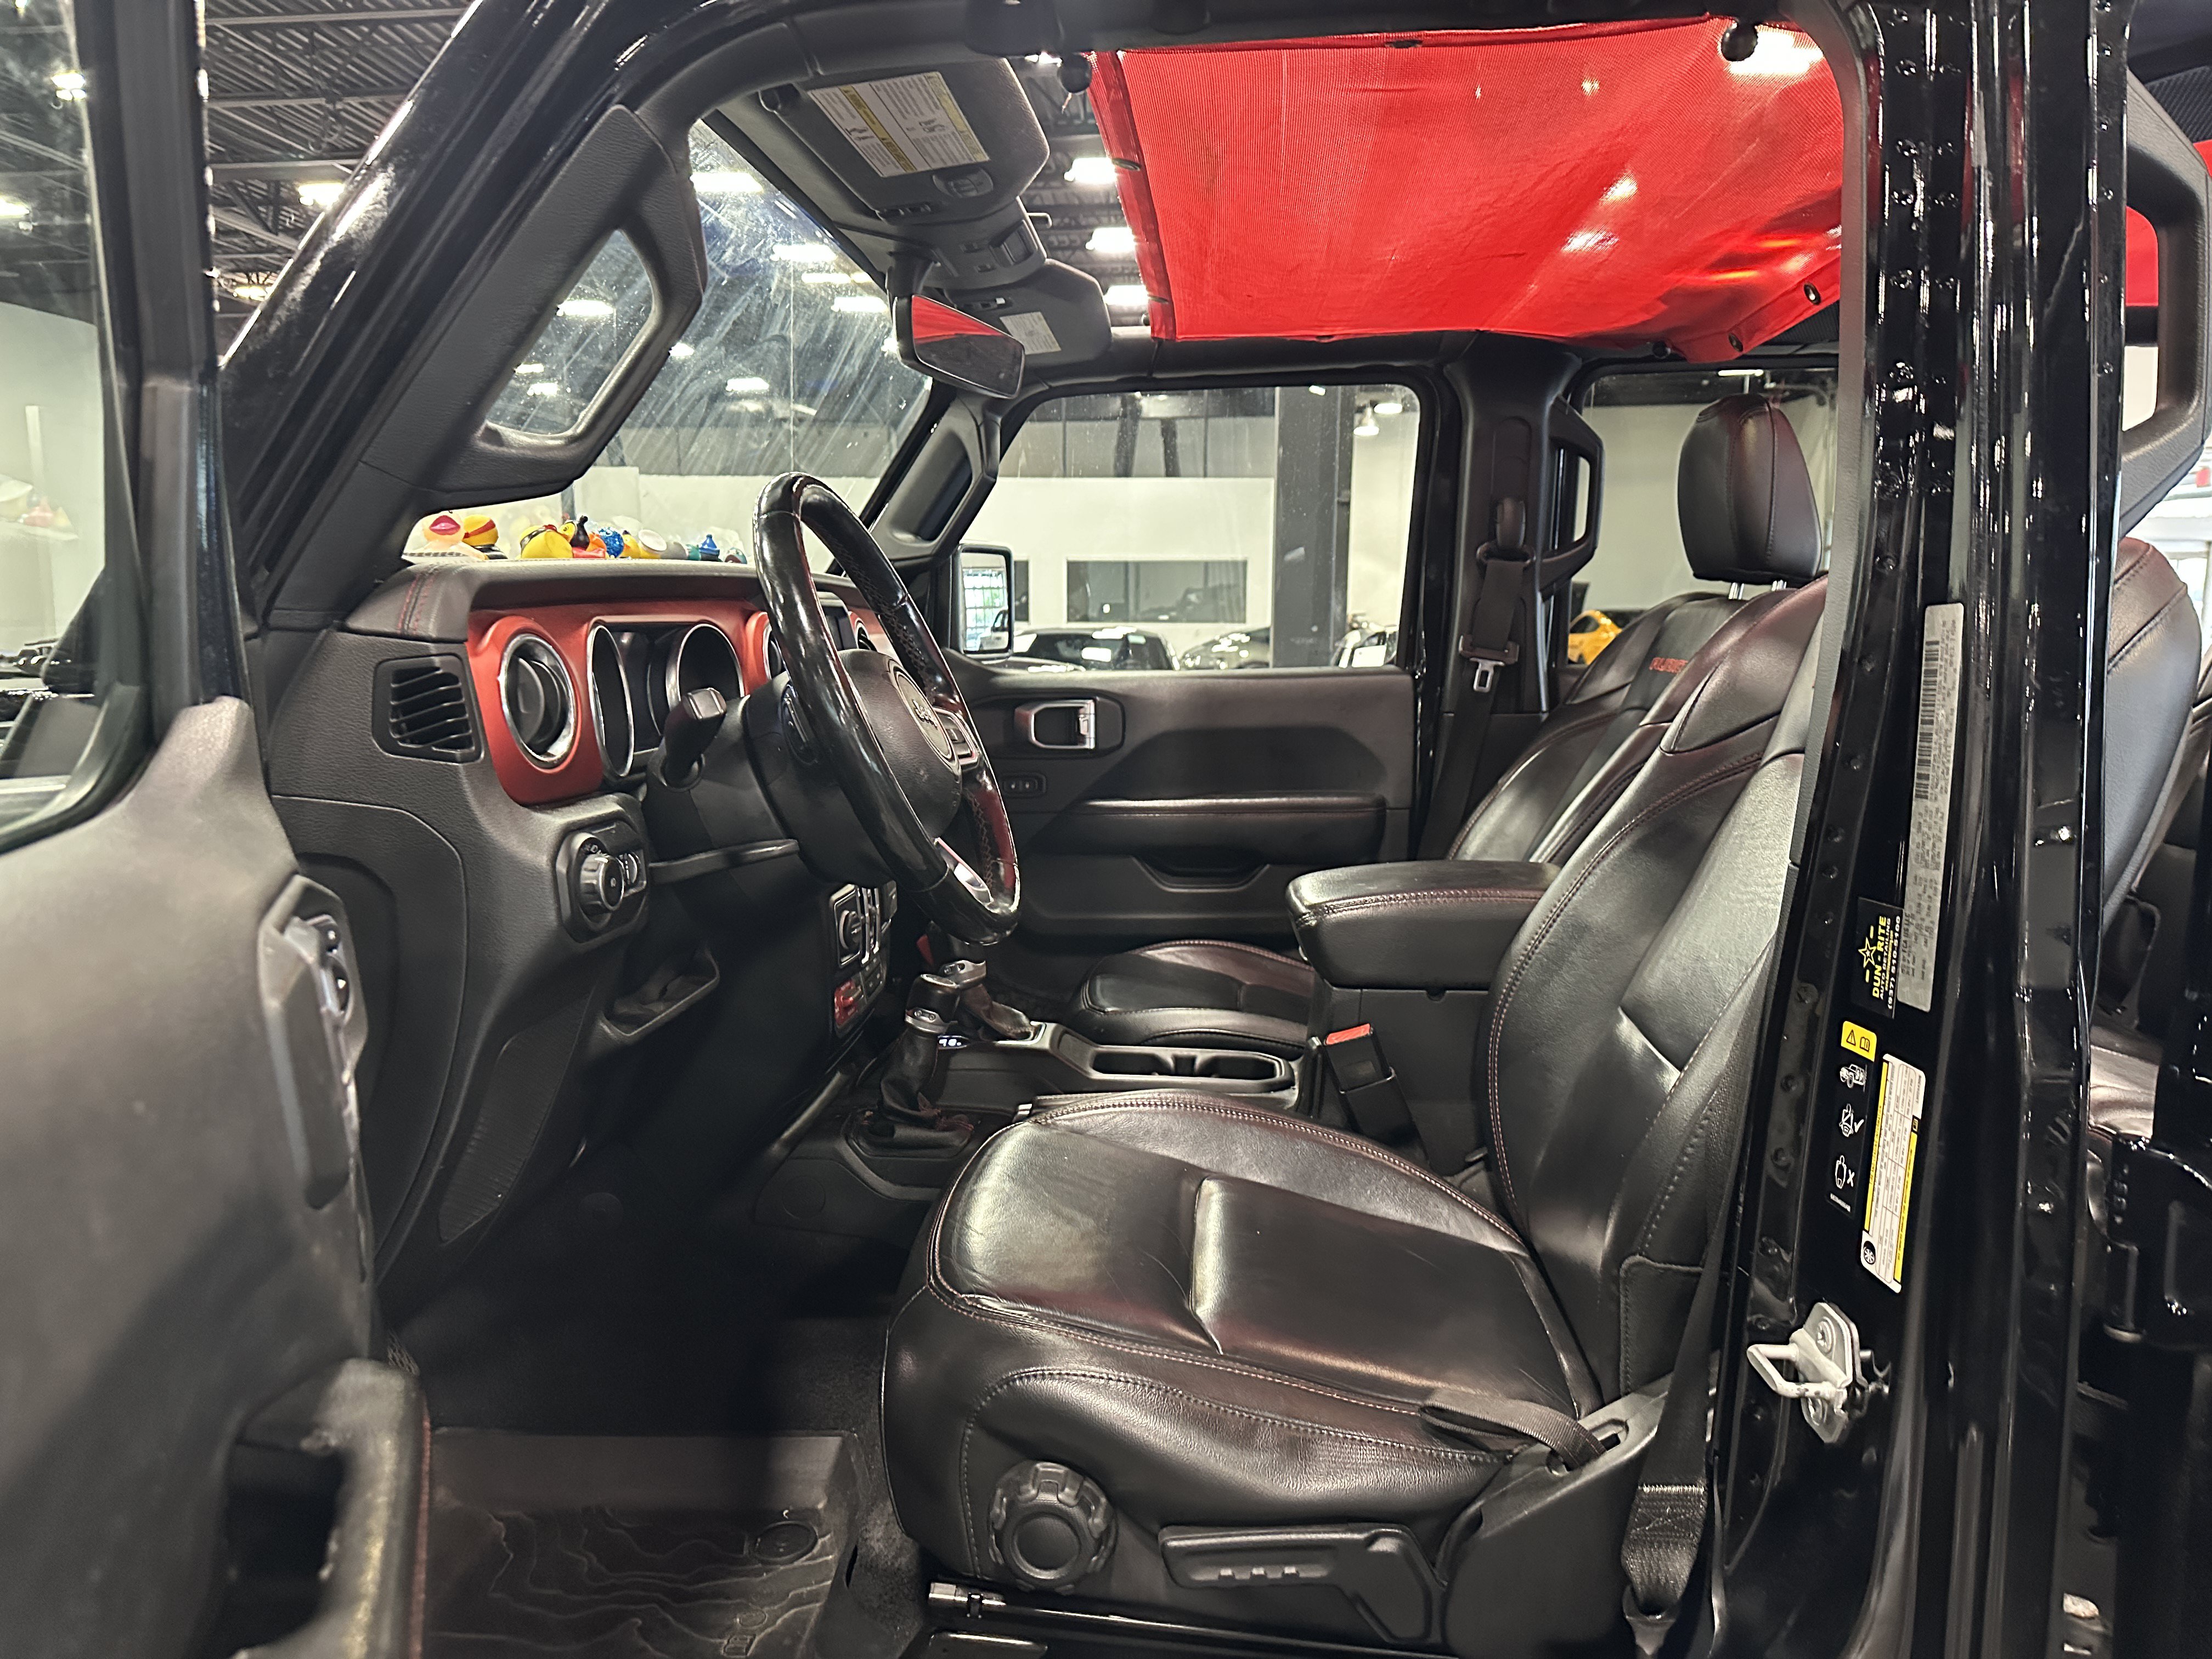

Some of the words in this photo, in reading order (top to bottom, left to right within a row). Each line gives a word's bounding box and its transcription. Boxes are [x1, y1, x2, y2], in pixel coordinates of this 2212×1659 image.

[1872, 964, 1882, 998] DUN
[1877, 916, 1886, 952] RITE
[1891, 916, 1900, 974] 510-5100
